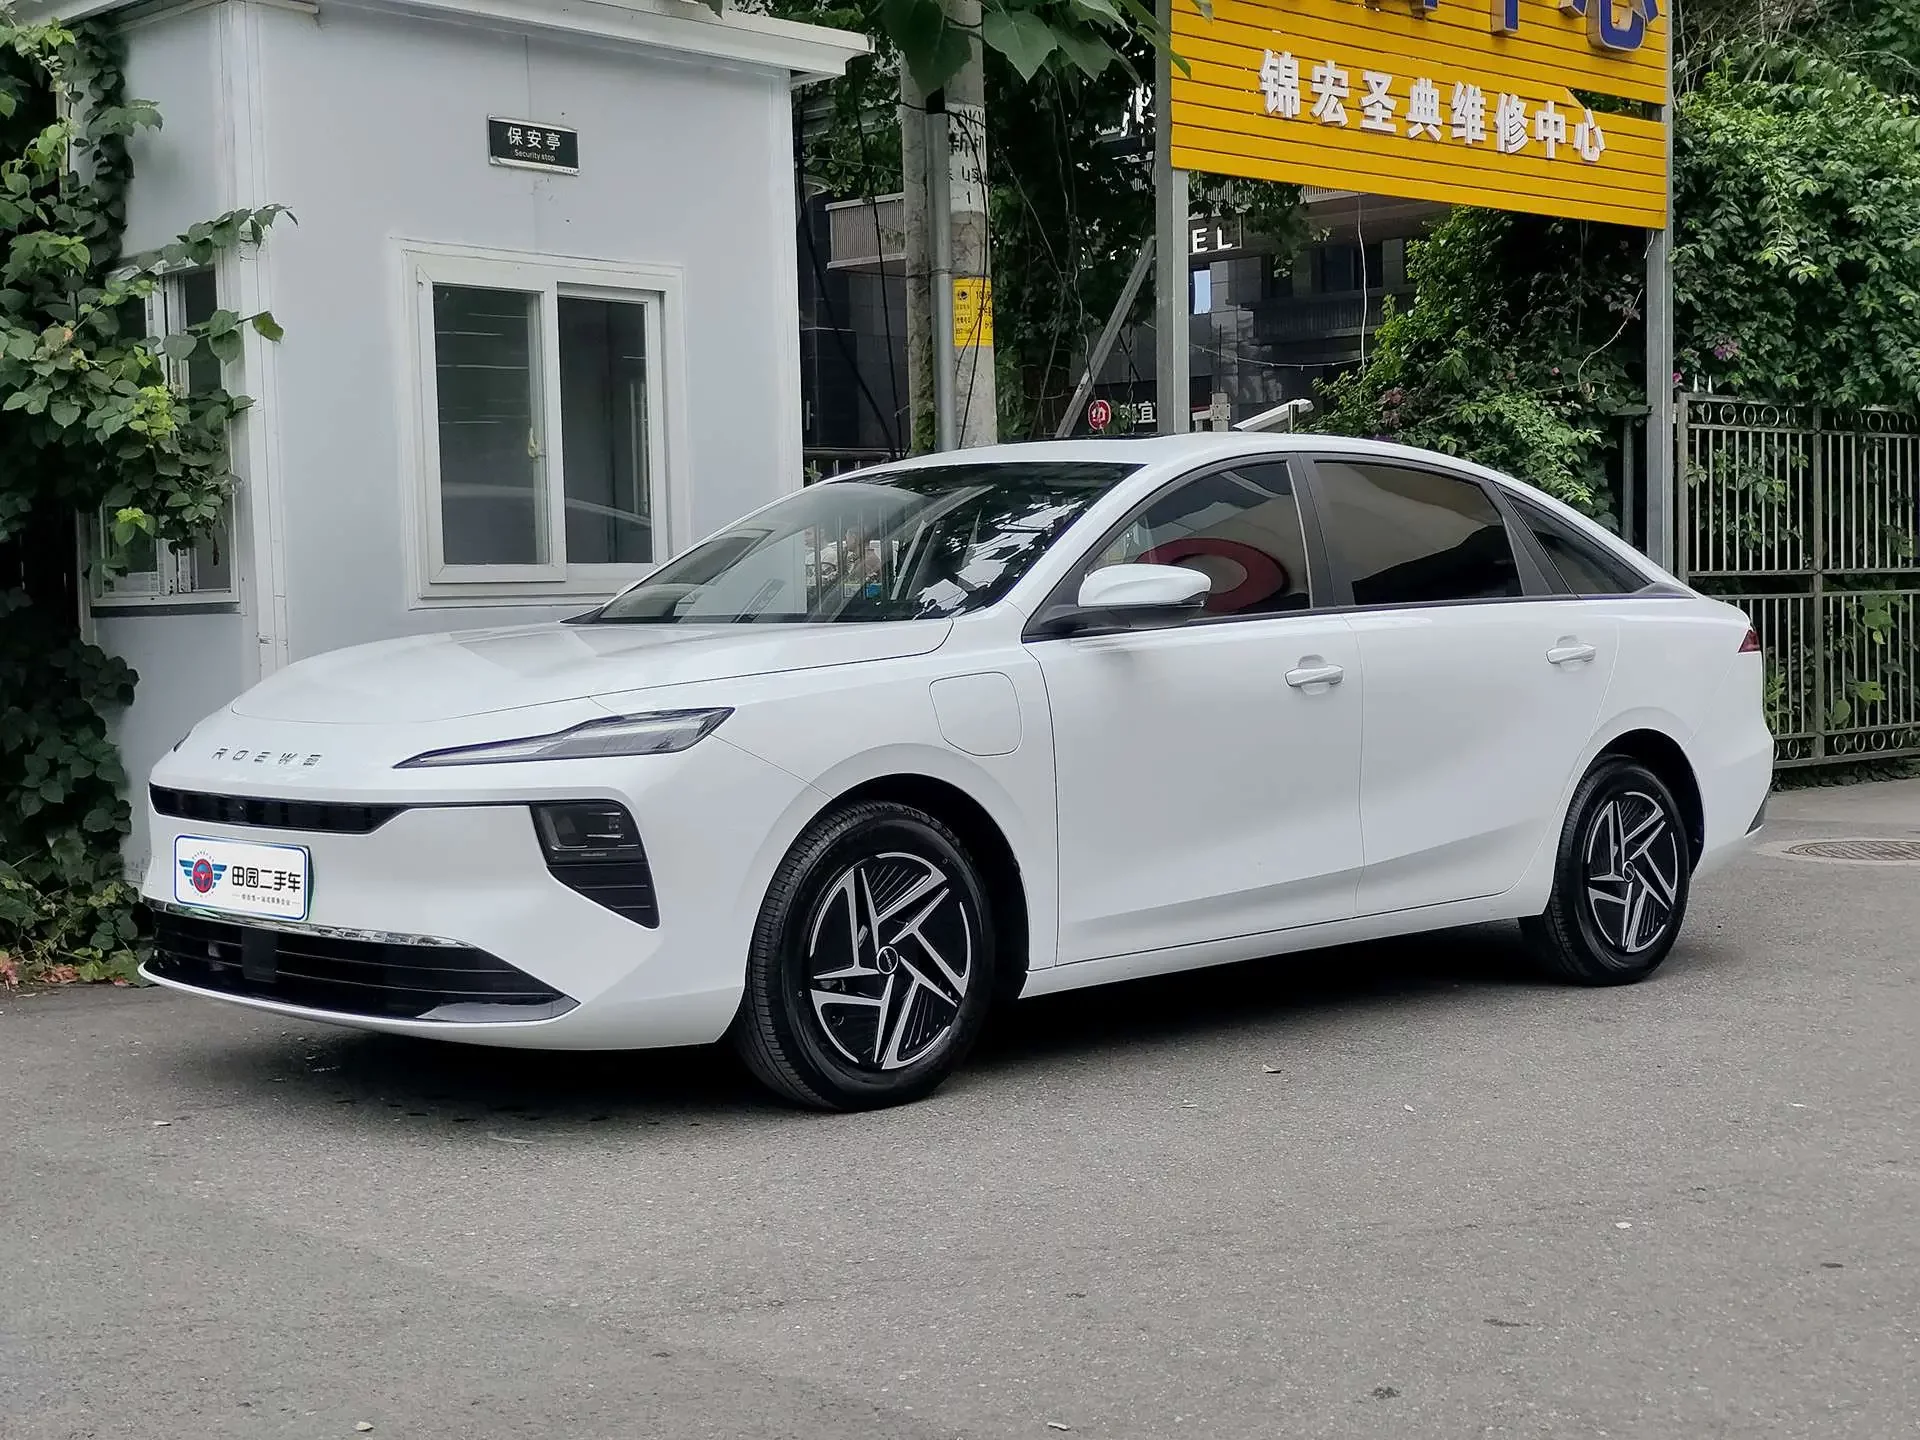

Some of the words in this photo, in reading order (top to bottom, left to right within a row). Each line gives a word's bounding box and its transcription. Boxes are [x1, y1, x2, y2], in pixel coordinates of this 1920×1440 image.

[1259, 48, 1606, 162] 锦宏圣典维修中心
[507, 126, 561, 150] 保安亭
[514, 149, 540, 160] Security
[211, 748, 322, 766] ROEWE
[232, 866, 301, 892] 田园二手车
